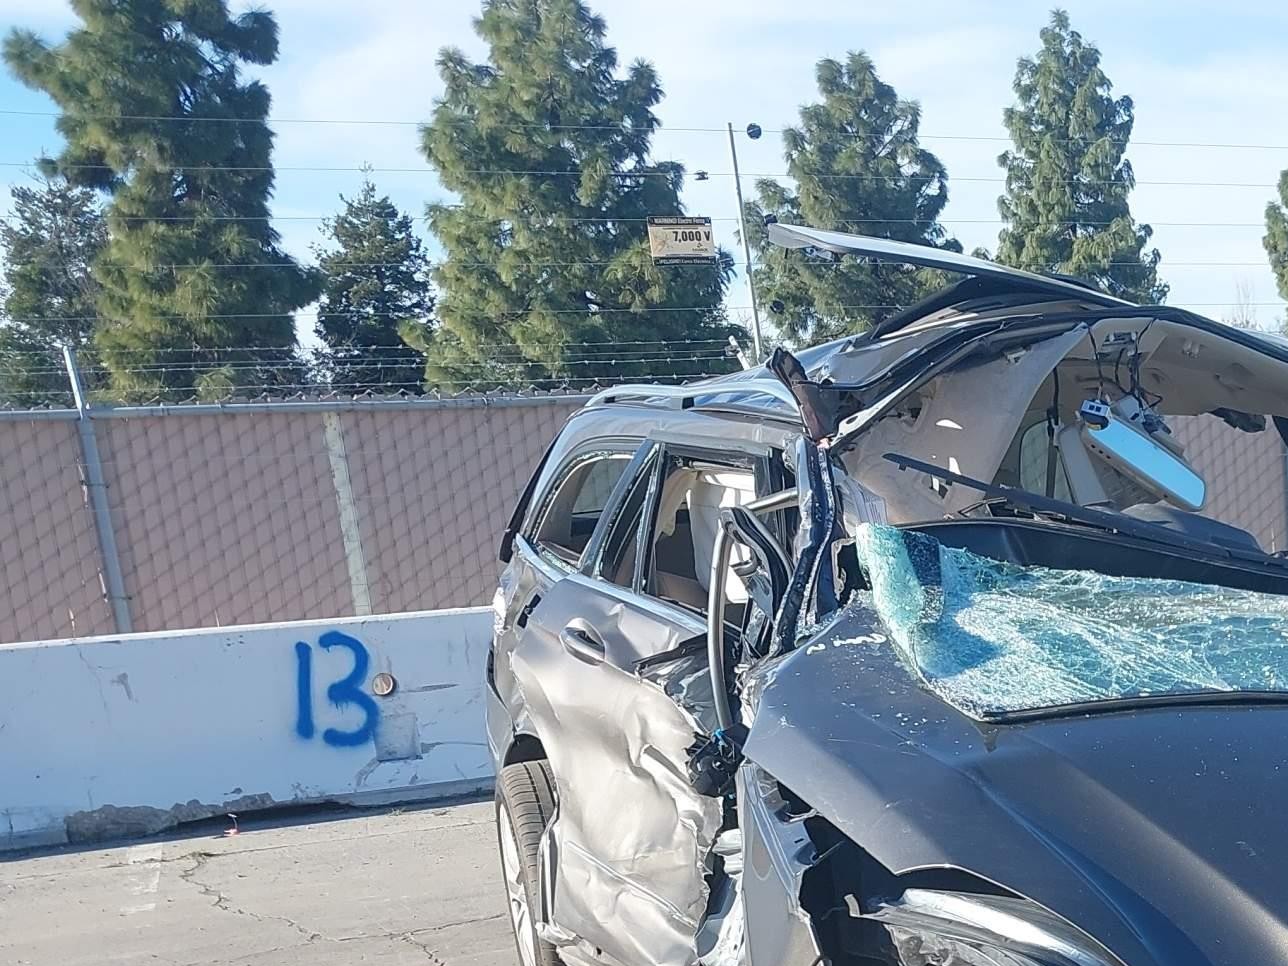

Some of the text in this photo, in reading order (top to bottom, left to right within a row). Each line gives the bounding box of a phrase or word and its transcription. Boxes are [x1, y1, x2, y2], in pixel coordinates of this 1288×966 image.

[673, 230, 710, 243] 7,000 V
[294, 630, 380, 747] 13
